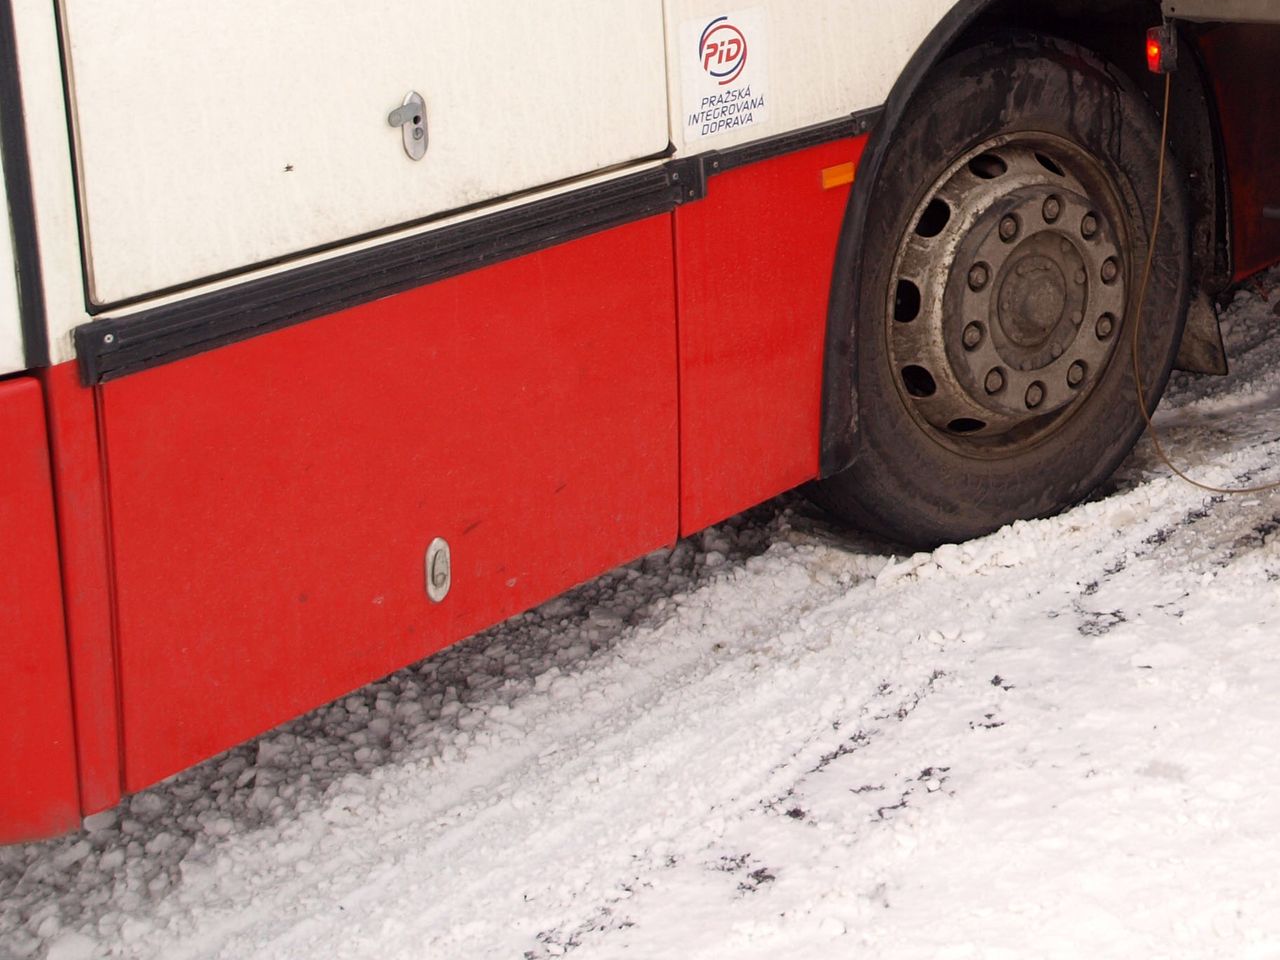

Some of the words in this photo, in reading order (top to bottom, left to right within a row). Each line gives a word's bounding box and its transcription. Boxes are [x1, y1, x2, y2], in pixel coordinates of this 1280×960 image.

[701, 84, 752, 109] PRAŽSKÁ
[688, 93, 765, 127] INTEGROVANÁ
[701, 112, 753, 136] DOPRAVA
